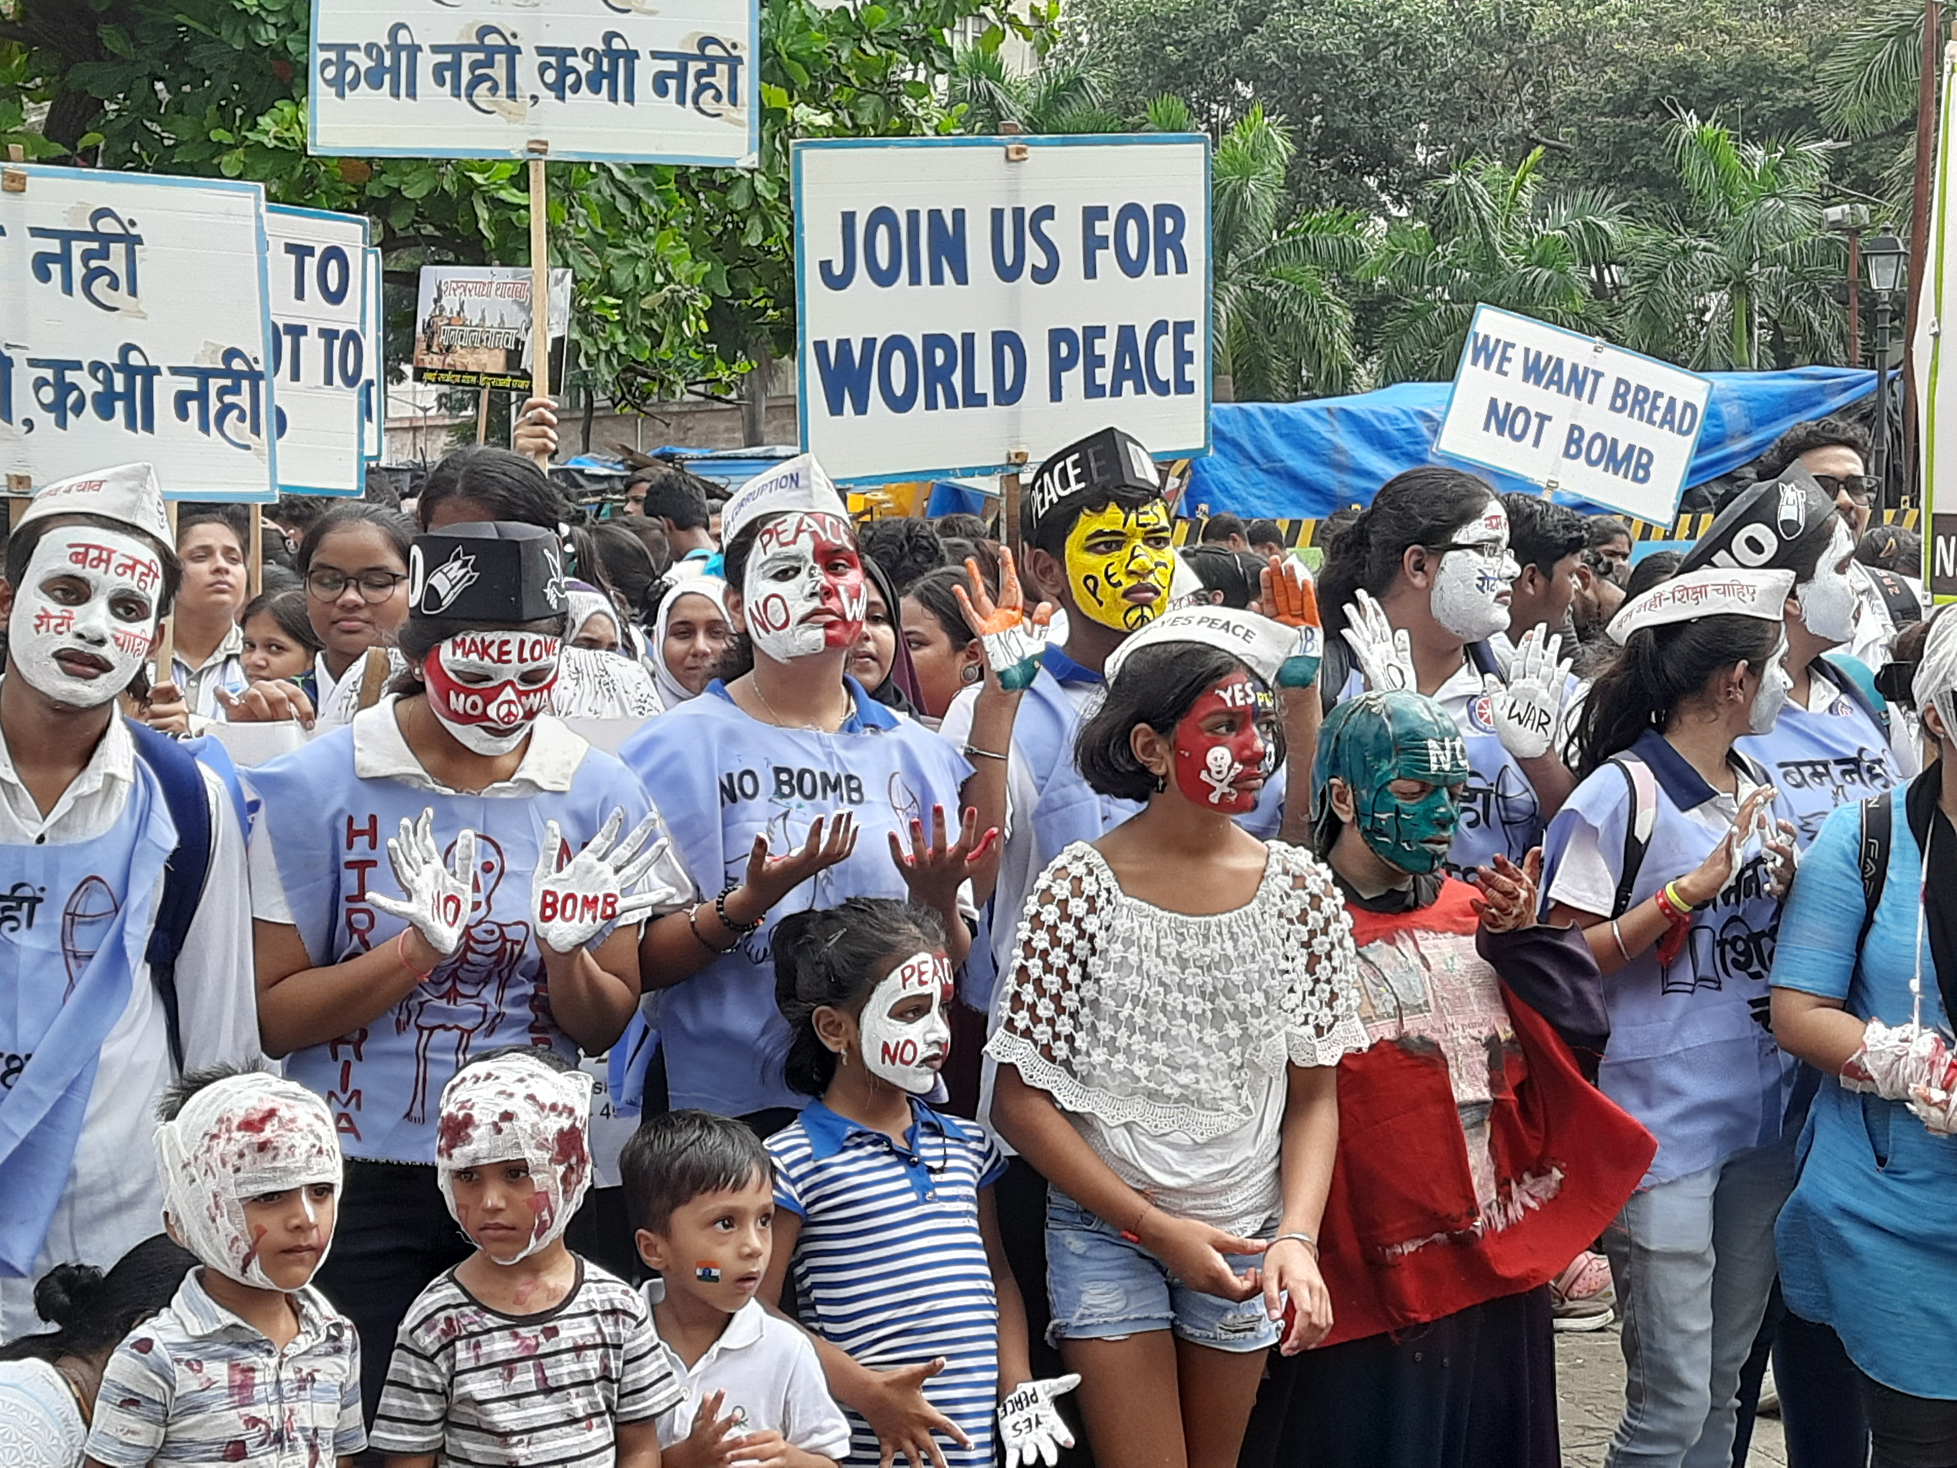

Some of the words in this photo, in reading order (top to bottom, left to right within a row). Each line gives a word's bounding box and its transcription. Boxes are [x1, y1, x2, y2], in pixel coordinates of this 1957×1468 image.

[317, 22, 423, 102] कभी
[534, 30, 640, 108] कभी
[649, 36, 746, 118] नहीं
[27, 207, 144, 312] नहीं
[818, 205, 969, 291] JOIN
[990, 203, 1061, 285] US
[1081, 202, 1188, 281] FOR
[284, 241, 351, 306] TO
[317, 326, 364, 389] TO
[813, 329, 1027, 416] WORLD
[1047, 318, 1196, 402] PEACE
[27, 342, 162, 434] कभी
[167, 346, 268, 451] नहीं
[1469, 331, 1513, 379] WE
[1521, 347, 1605, 402] WANT
[1608, 376, 1699, 438] BREAD
[1483, 397, 1552, 448] NOT
[1562, 426, 1655, 486] BOMB
[1031, 452, 1086, 530] PEACE
[66, 542, 117, 575] बम
[1710, 579, 1759, 604] चाहिए
[748, 592, 790, 640] NO
[1196, 616, 1257, 645] PEACE
[452, 637, 513, 664] MAKE
[449, 689, 485, 716] NO
[1214, 682, 1256, 708] YES
[1507, 700, 1552, 737] WAR
[719, 768, 760, 806] NO
[773, 766, 865, 805] BOMB
[540, 889, 620, 926] BOMB
[881, 1038, 919, 1066] NO
[1000, 1387, 1039, 1420] PEACE
[1011, 1413, 1043, 1438] YES
